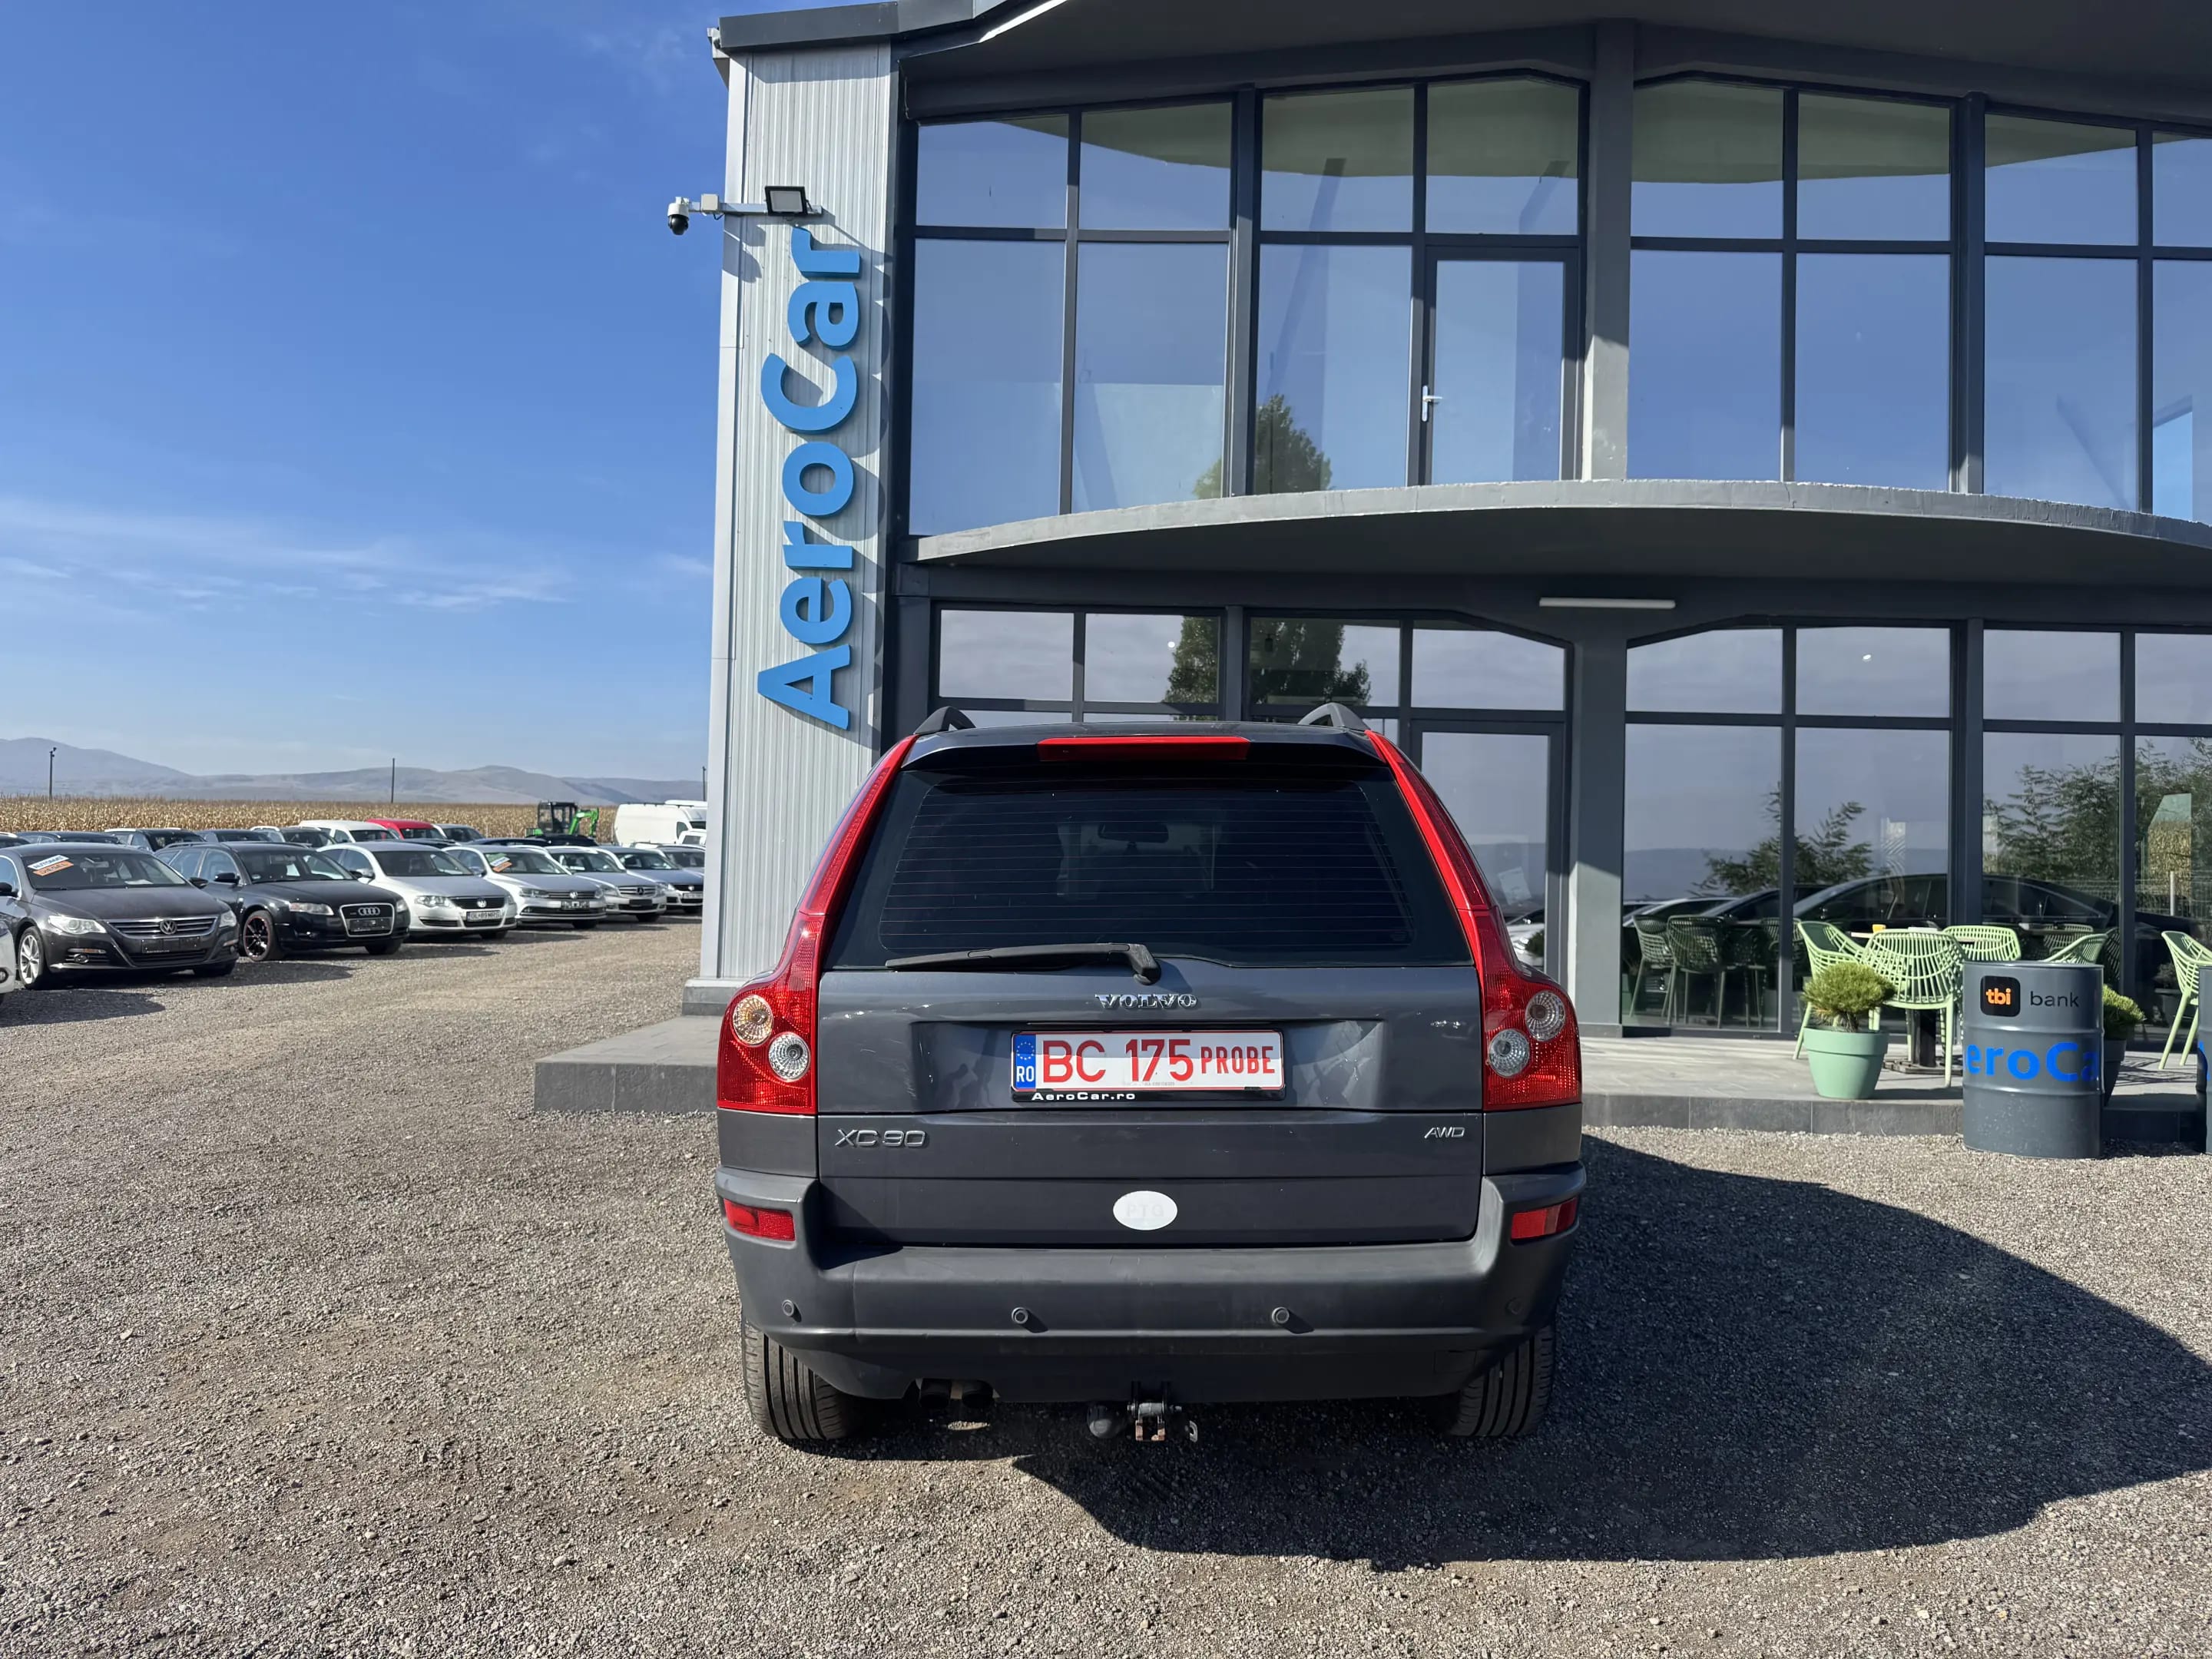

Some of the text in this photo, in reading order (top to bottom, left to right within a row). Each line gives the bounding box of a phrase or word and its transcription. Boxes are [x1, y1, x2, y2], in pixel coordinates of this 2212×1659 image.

[757, 226, 861, 730] AeroCar
[1094, 993, 1197, 1008] VOLVO
[1985, 988, 2079, 1008] tbi bank
[1042, 1038, 1275, 1083] BC 175 PROBE
[1016, 1065, 1035, 1082] RO
[1031, 1091, 1135, 1101] AeroCar.ro
[835, 1129, 926, 1147] XC90
[1424, 1126, 1465, 1139] AWD
